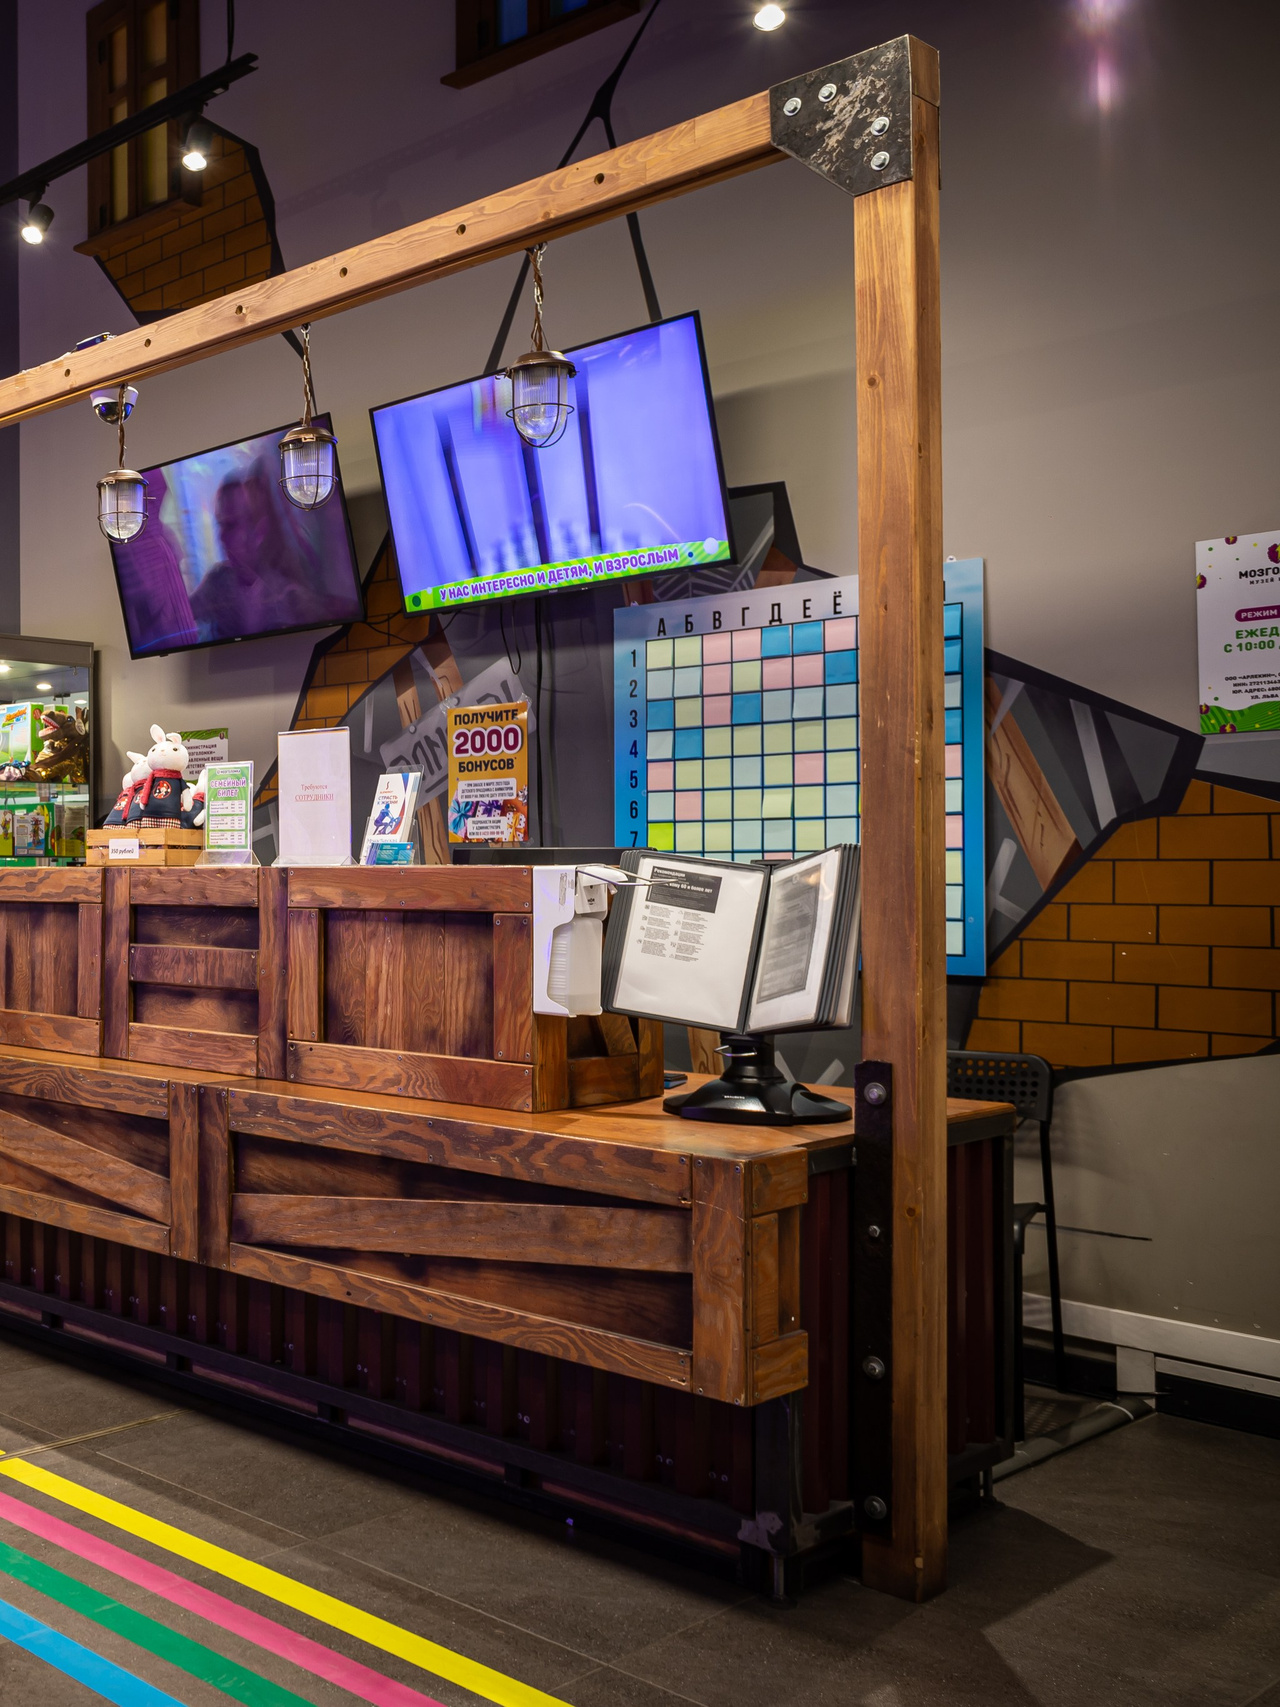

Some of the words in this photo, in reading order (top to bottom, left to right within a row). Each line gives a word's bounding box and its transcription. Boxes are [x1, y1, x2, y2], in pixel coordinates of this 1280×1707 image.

[439, 589, 446, 600] У
[448, 585, 469, 599] НАС
[471, 574, 535, 595] ИНТЕРЕСНО
[537, 572, 545, 583] И
[548, 564, 592, 584] ДЕТЯМ,
[594, 561, 603, 573] И
[606, 548, 679, 572] ВЗРОСЛЫМ
[1249, 577, 1275, 585] МУЗЕЙ
[657, 618, 666, 636] А
[685, 614, 694, 633] Б
[713, 611, 722, 630] В
[741, 607, 750, 626] Г
[769, 603, 783, 625] Д
[803, 599, 812, 618] Е
[833, 591, 842, 615] Ё
[1241, 609, 1278, 619] РЕЖИМ
[1235, 626, 1280, 640] ЕЖЕД
[1223, 643, 1233, 653] С
[1236, 640, 1275, 652] 10:00
[631, 649, 637, 667] 1
[629, 679, 638, 698] 2
[454, 709, 518, 726] ПОЛУЧИТЕ
[629, 710, 638, 728] 3
[454, 726, 520, 755] 2000
[629, 740, 639, 758] 4
[458, 758, 515, 773] БОНУСОВ
[210, 777, 247, 788] СЕМЕЙНЫЙ
[630, 770, 638, 788] 5
[217, 789, 239, 797] БИЛЕТ
[629, 800, 638, 819] 6
[629, 831, 638, 848] 7
[653, 867, 686, 878] Рекомендации
